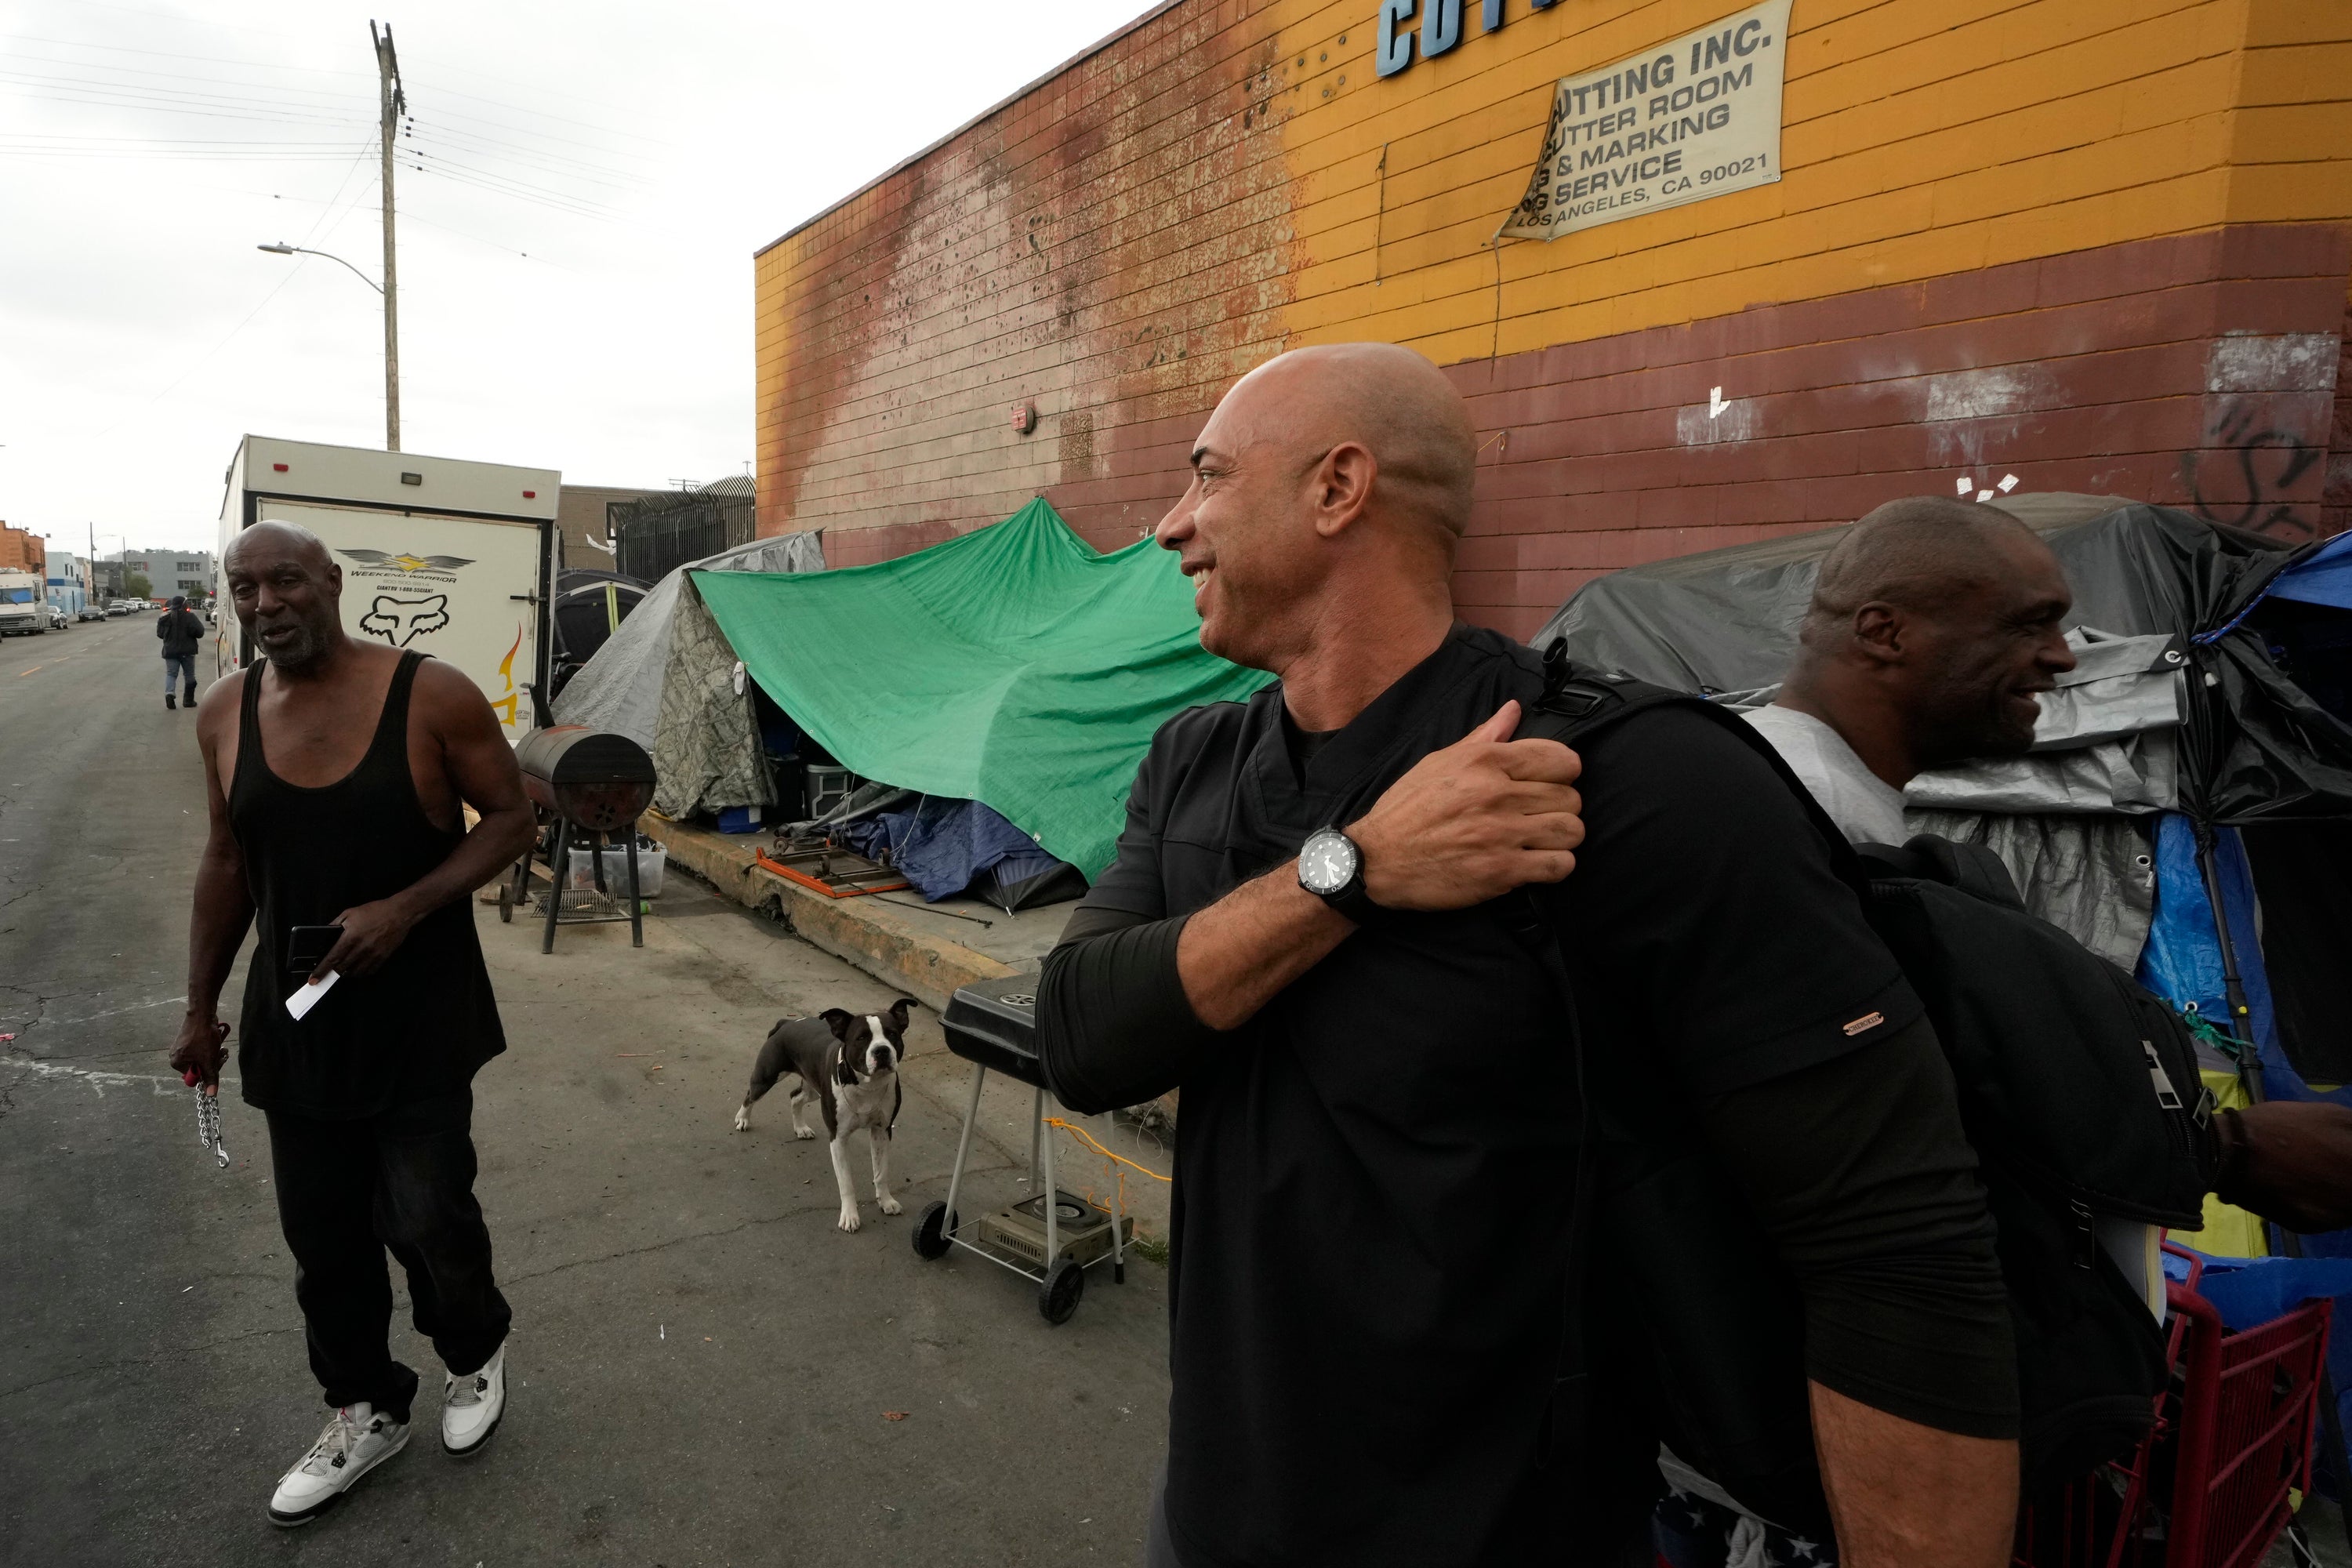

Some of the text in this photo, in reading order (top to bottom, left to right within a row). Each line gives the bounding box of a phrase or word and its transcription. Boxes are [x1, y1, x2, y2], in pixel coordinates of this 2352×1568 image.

[1690, 19, 1772, 76] INC.
[1649, 62, 1753, 121] ROOM
[1556, 155, 1573, 176] &
[1581, 103, 1730, 171] MARKING
[1516, 153, 1767, 227] LOS ANGELES, CA 90021
[1555, 149, 1682, 206] SERVICE
[409, 574, 457, 584] WARRIOR
[1848, 1015, 1879, 1033] CHEROKEE
